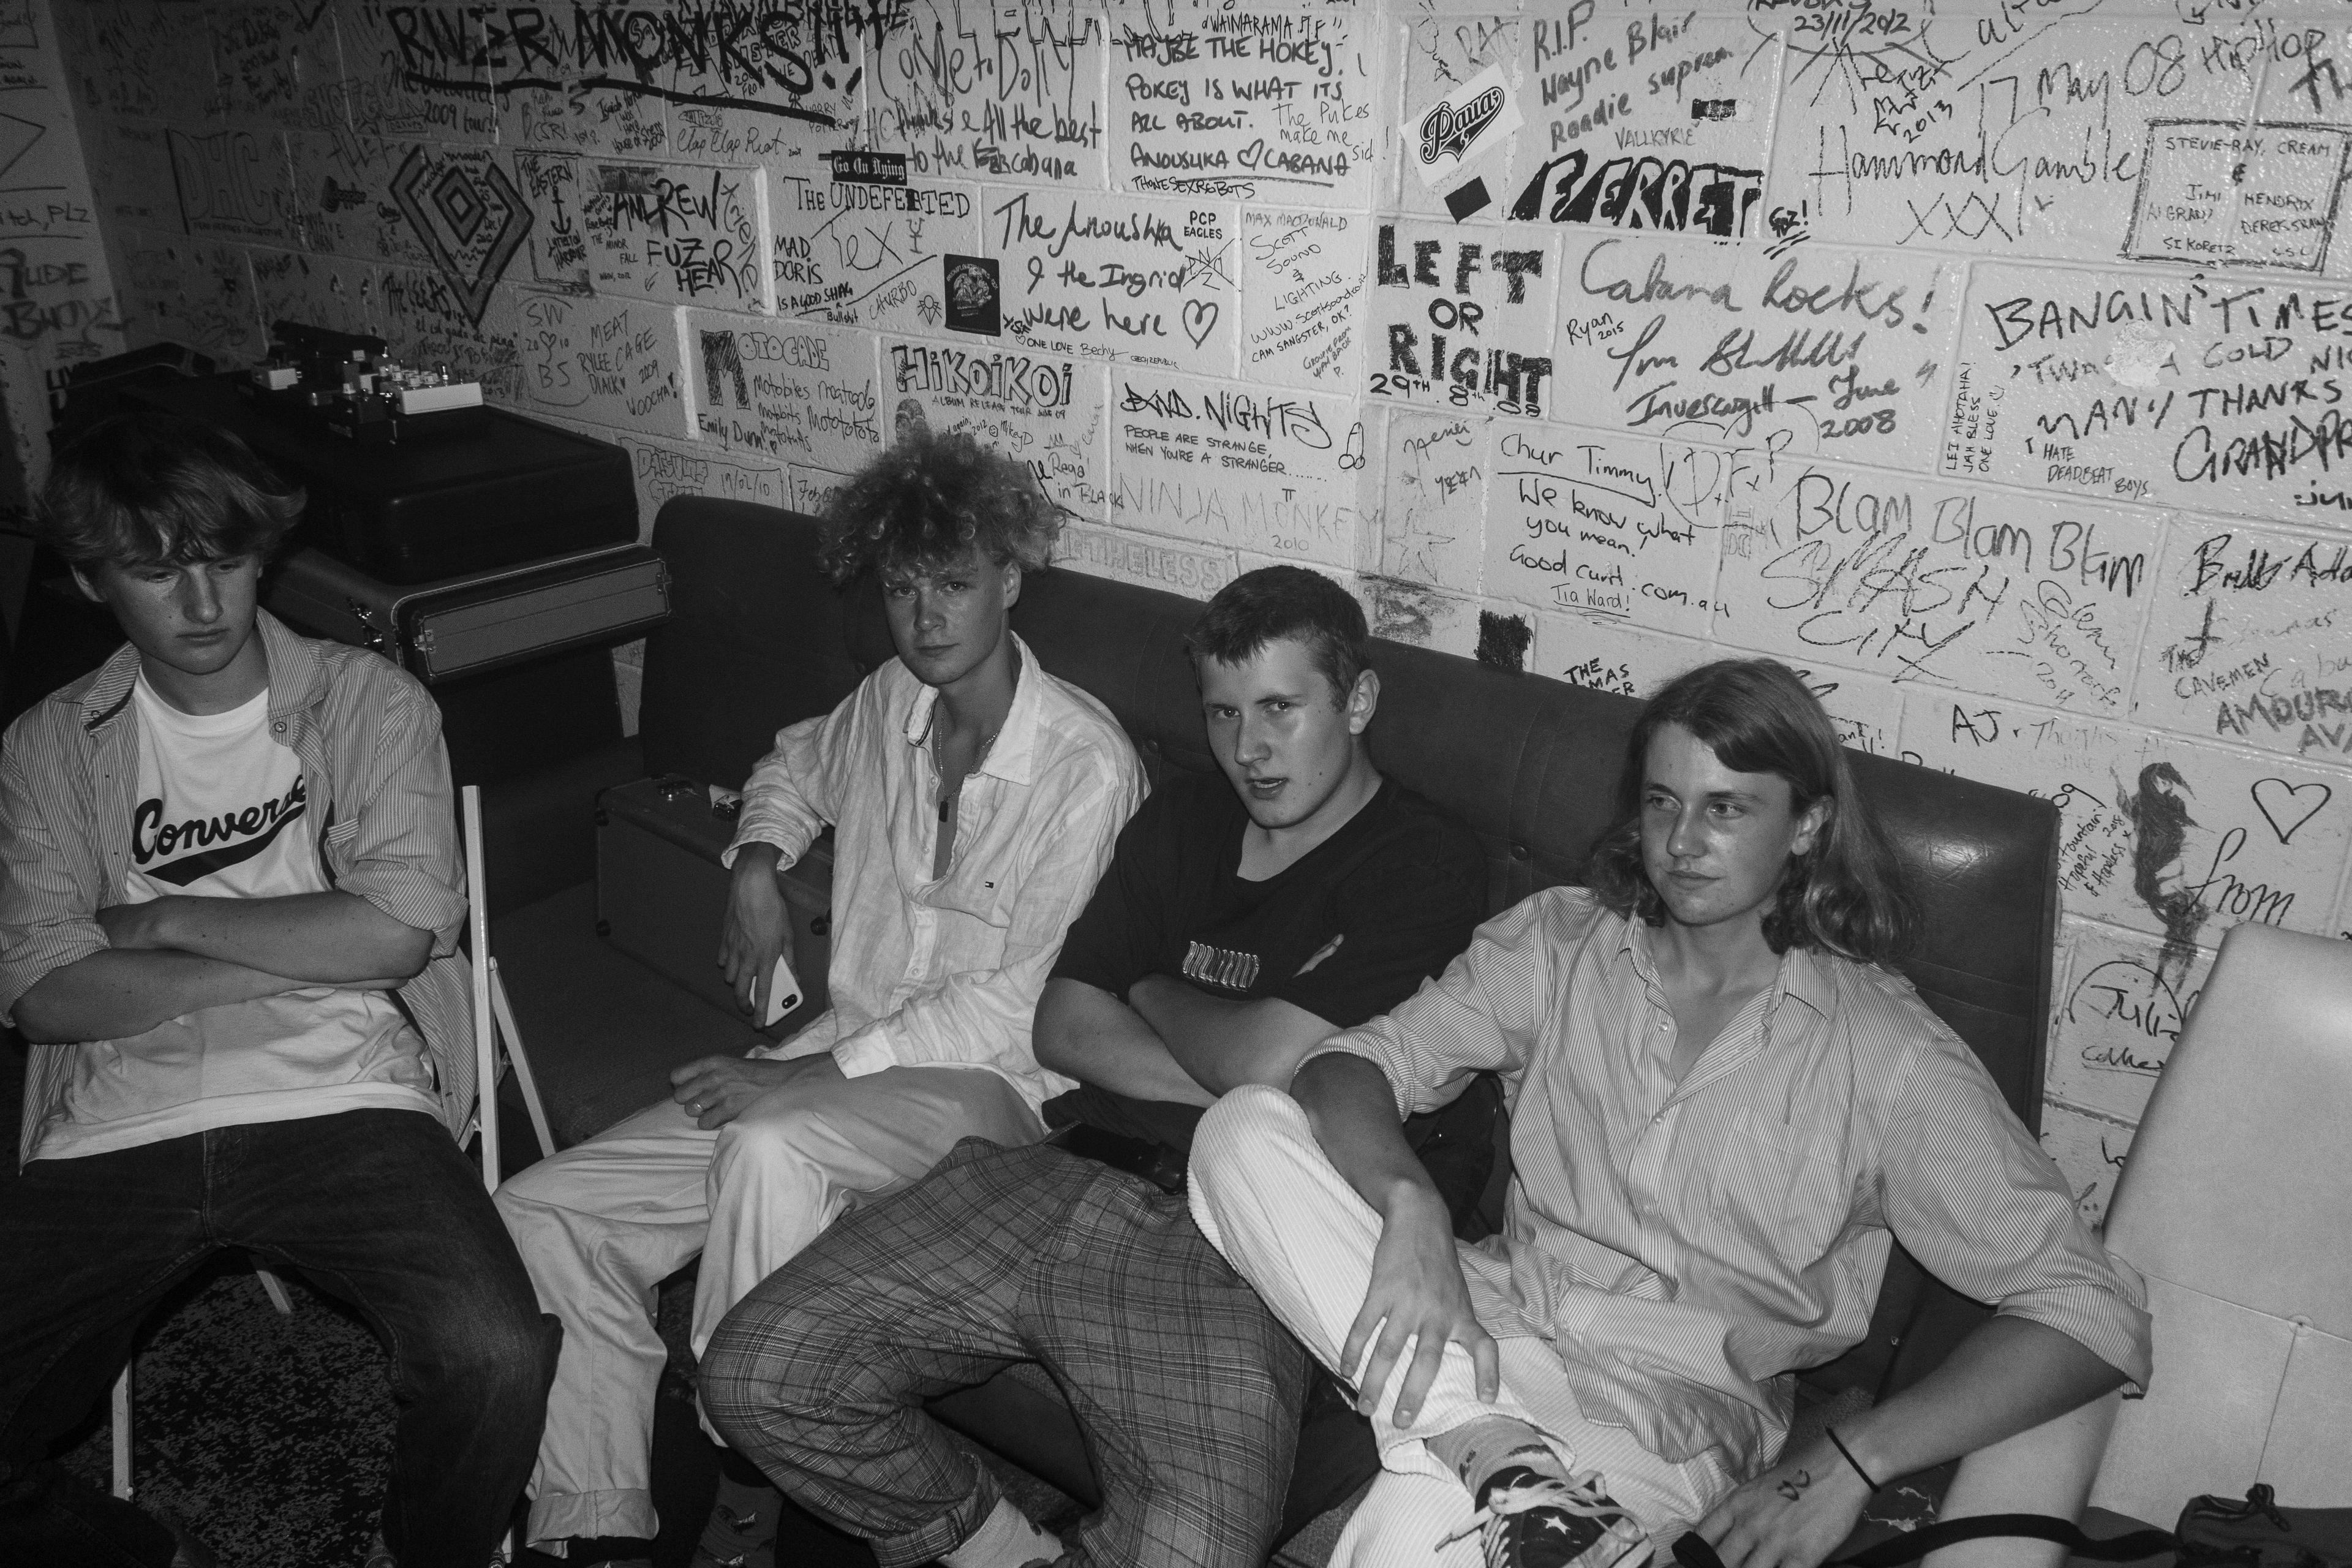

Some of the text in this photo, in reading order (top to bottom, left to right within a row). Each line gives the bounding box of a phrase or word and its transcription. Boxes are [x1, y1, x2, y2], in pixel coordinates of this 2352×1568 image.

[1205, 35, 1253, 59] THE
[1232, 75, 1303, 101] WHAT
[1189, 210, 1217, 226] PCP
[1183, 226, 1223, 240] EAGLES
[1378, 224, 1544, 305] LEFT
[1428, 298, 1484, 337] OR
[1387, 322, 1553, 405] RIGHT
